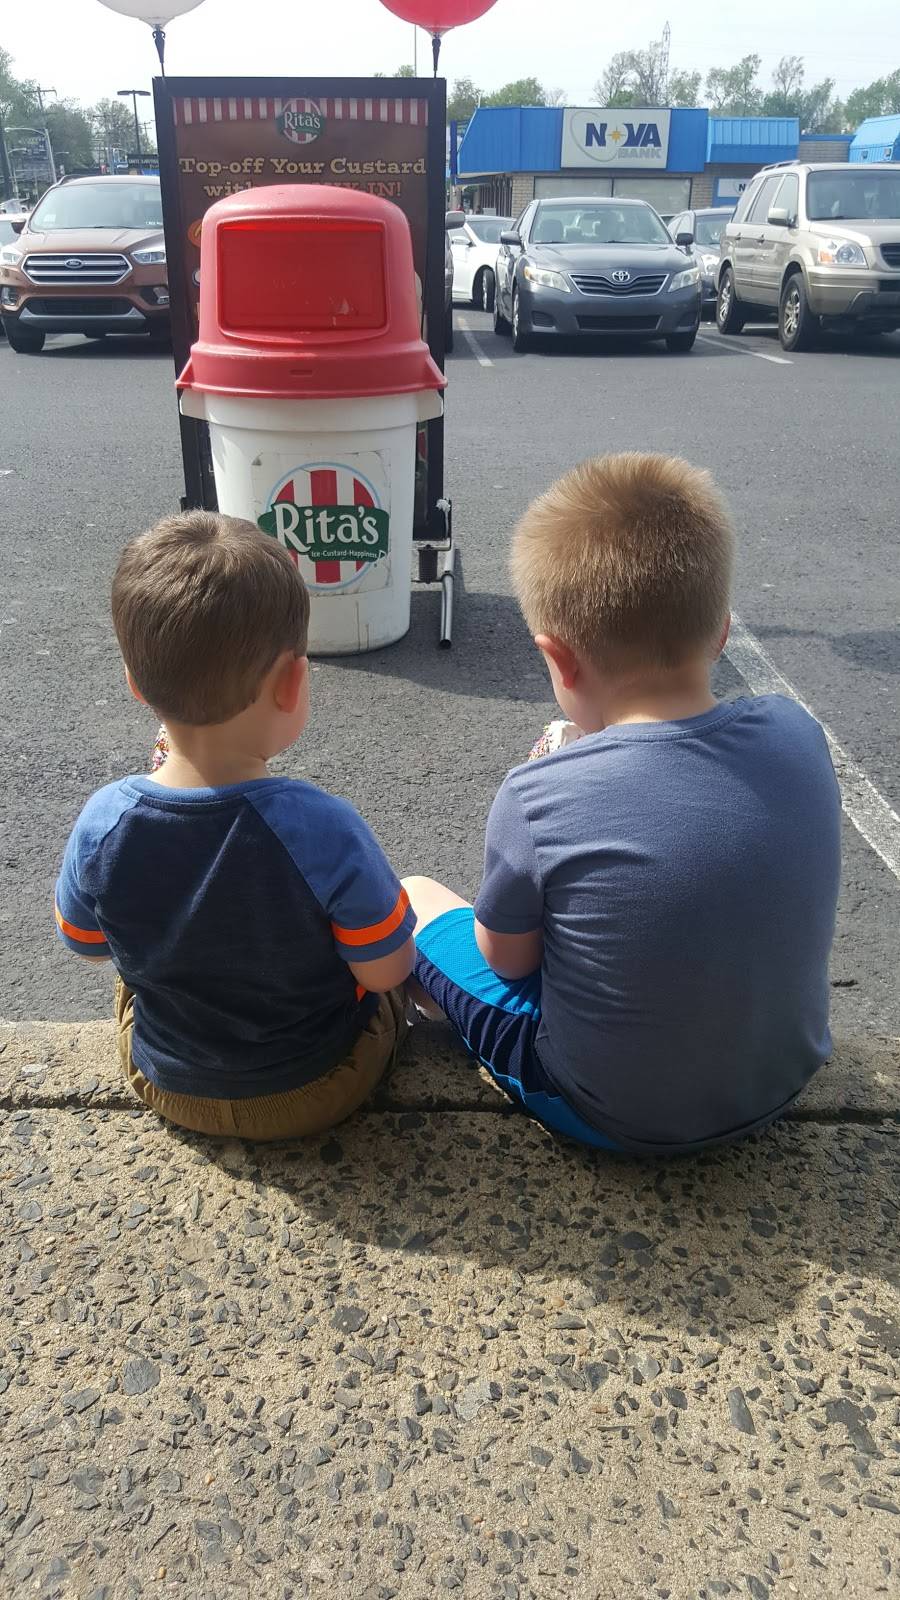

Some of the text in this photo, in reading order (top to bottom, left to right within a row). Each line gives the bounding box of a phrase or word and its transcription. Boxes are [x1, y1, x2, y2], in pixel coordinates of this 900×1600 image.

[284, 111, 321, 130] Rita's
[617, 148, 662, 159] BANK
[179, 157, 265, 177] Top-off
[270, 158, 325, 174] Your
[329, 157, 427, 174] Custard
[273, 503, 380, 553] Rita's
